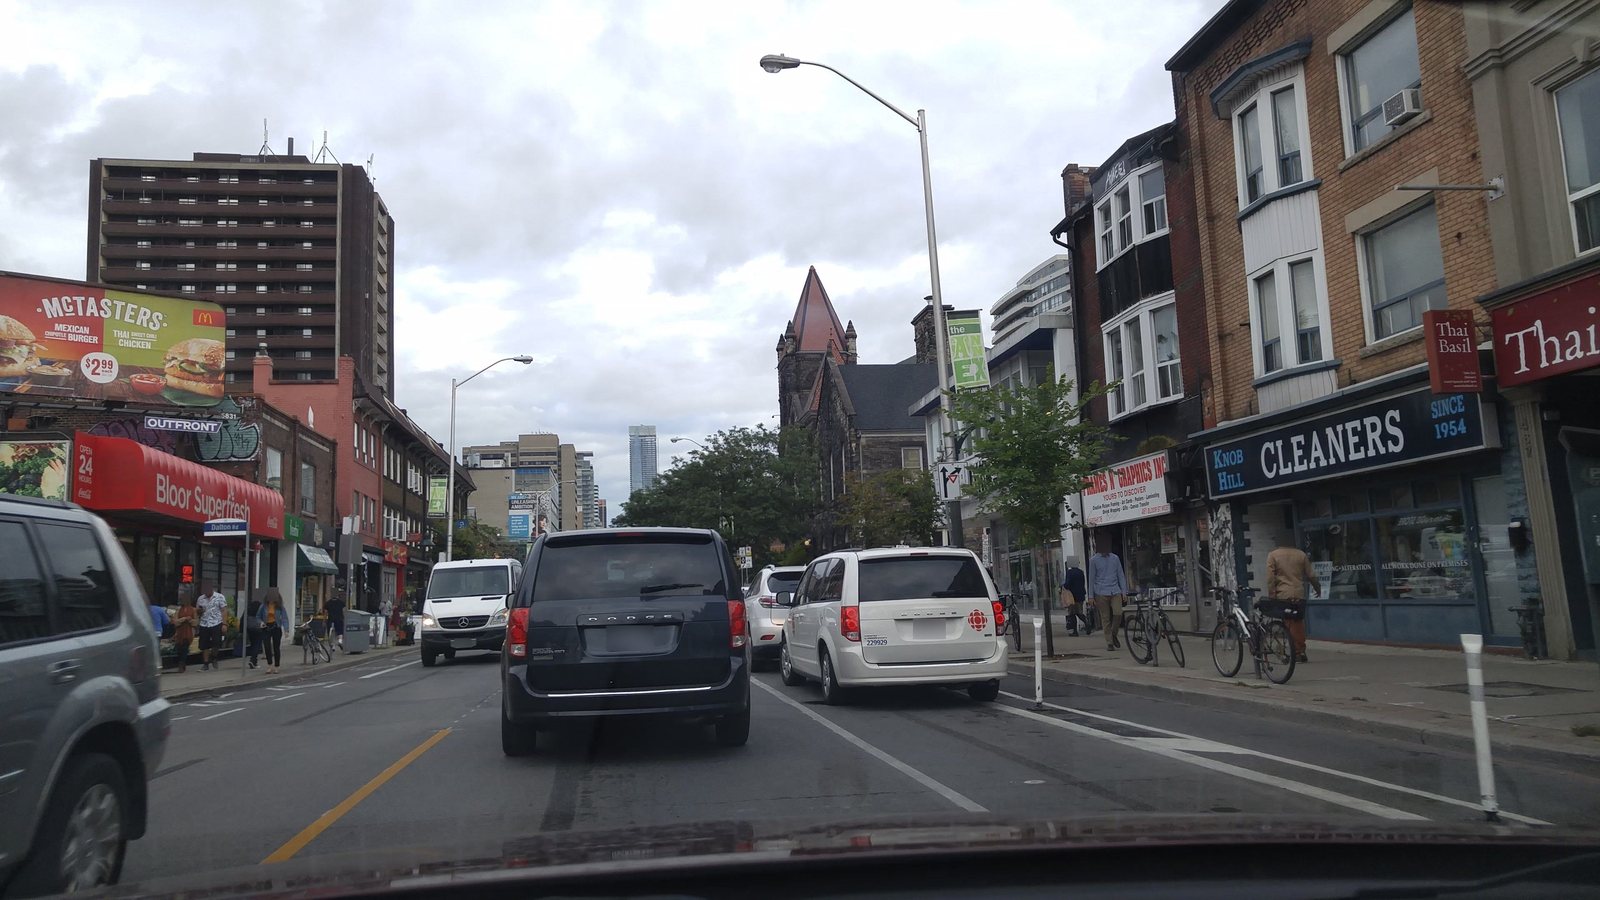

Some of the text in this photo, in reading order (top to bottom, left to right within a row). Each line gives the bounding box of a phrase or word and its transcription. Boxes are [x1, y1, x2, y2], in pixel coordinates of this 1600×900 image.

[54, 323, 90, 334] MEXICAN
[113, 329, 130, 338] THAI
[950, 326, 965, 334] the
[1436, 321, 1469, 337] Thai
[68, 333, 98, 344] BURGER
[118, 338, 152, 349] CHICKEN
[1438, 337, 1472, 353] Basil
[1505, 306, 1600, 374] Thai
[1431, 394, 1465, 420] SINCE
[147, 418, 218, 432] OUTFRONT
[1434, 418, 1467, 440] 1954
[79, 444, 93, 456] OPEN
[1260, 409, 1405, 479] CLEANERS
[78, 454, 93, 476] 24
[1117, 460, 1153, 488] GRAPHICS
[156, 473, 251, 522] Bloor Superfresh
[1117, 490, 1123, 498] TO
[1123, 486, 1147, 497] DISCOVER
